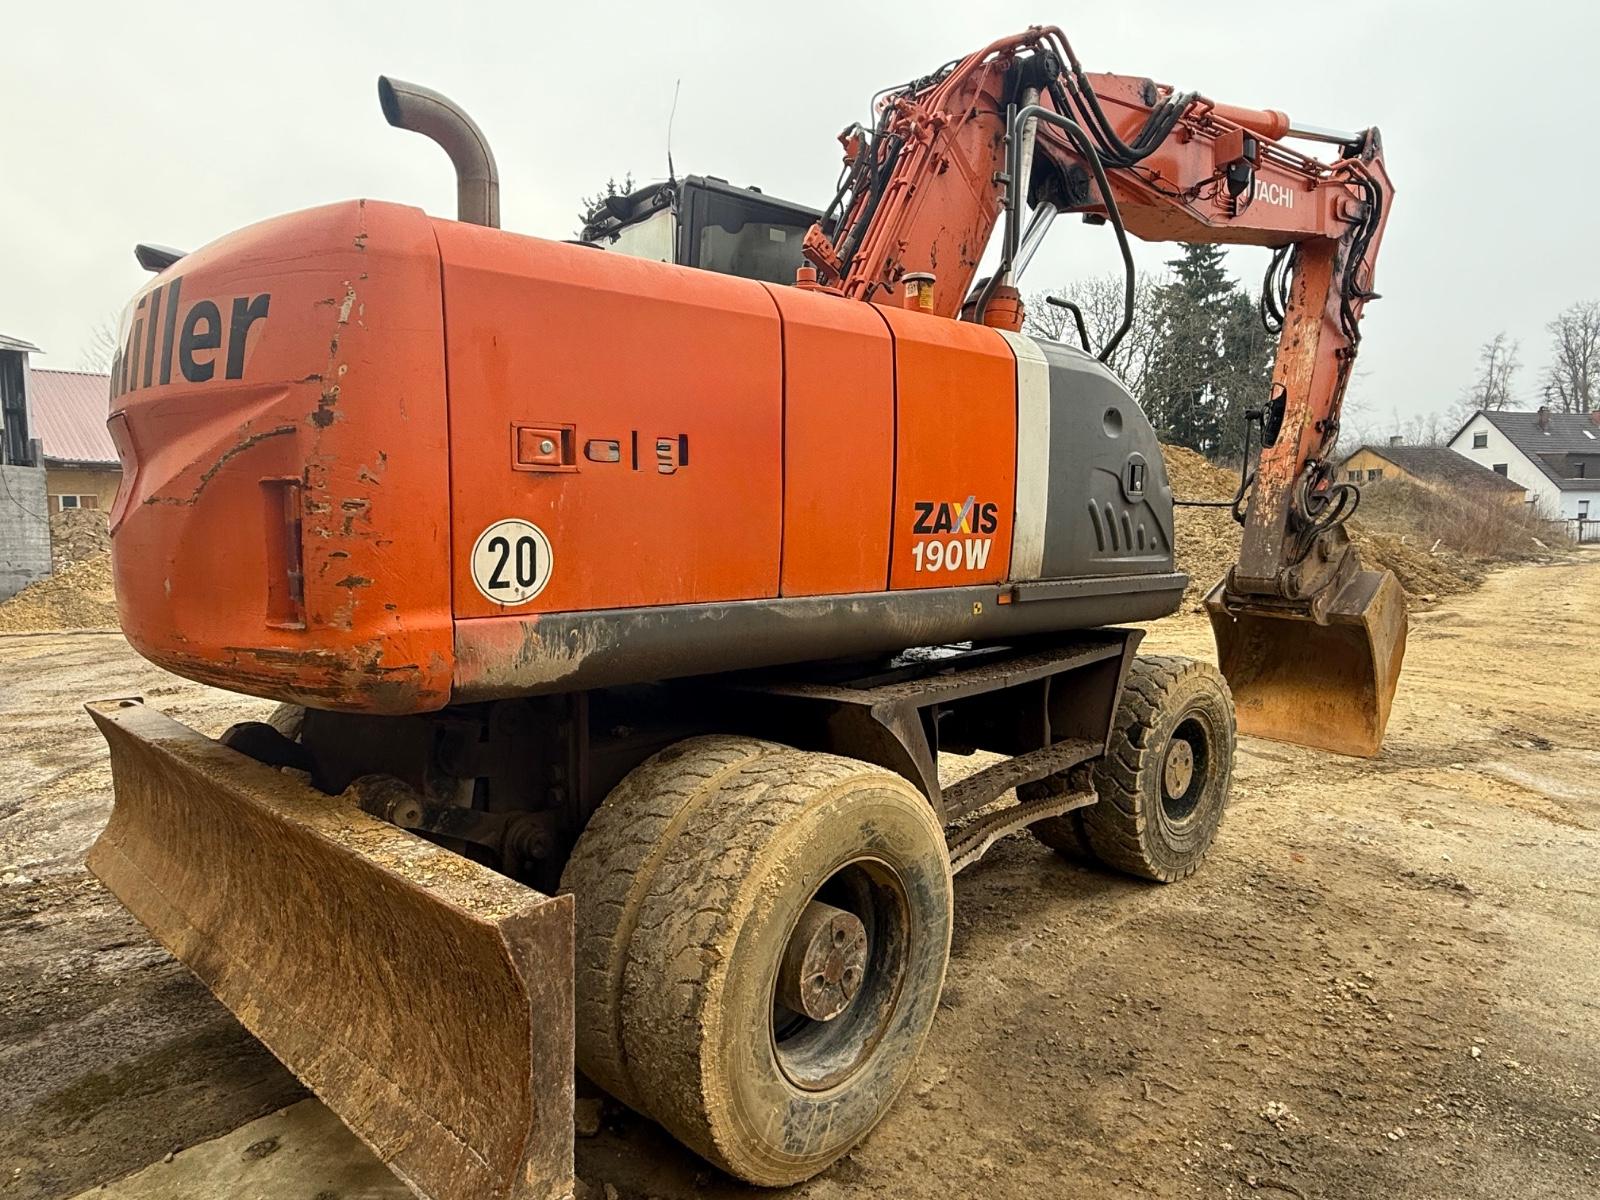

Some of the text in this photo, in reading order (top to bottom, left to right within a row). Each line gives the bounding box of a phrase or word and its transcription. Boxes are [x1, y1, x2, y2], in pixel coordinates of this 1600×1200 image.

[1244, 179, 1294, 209] TACHI
[109, 276, 272, 401] iller
[912, 496, 998, 534] ZAXIS
[487, 535, 537, 590] 20
[911, 539, 992, 572] 190W
